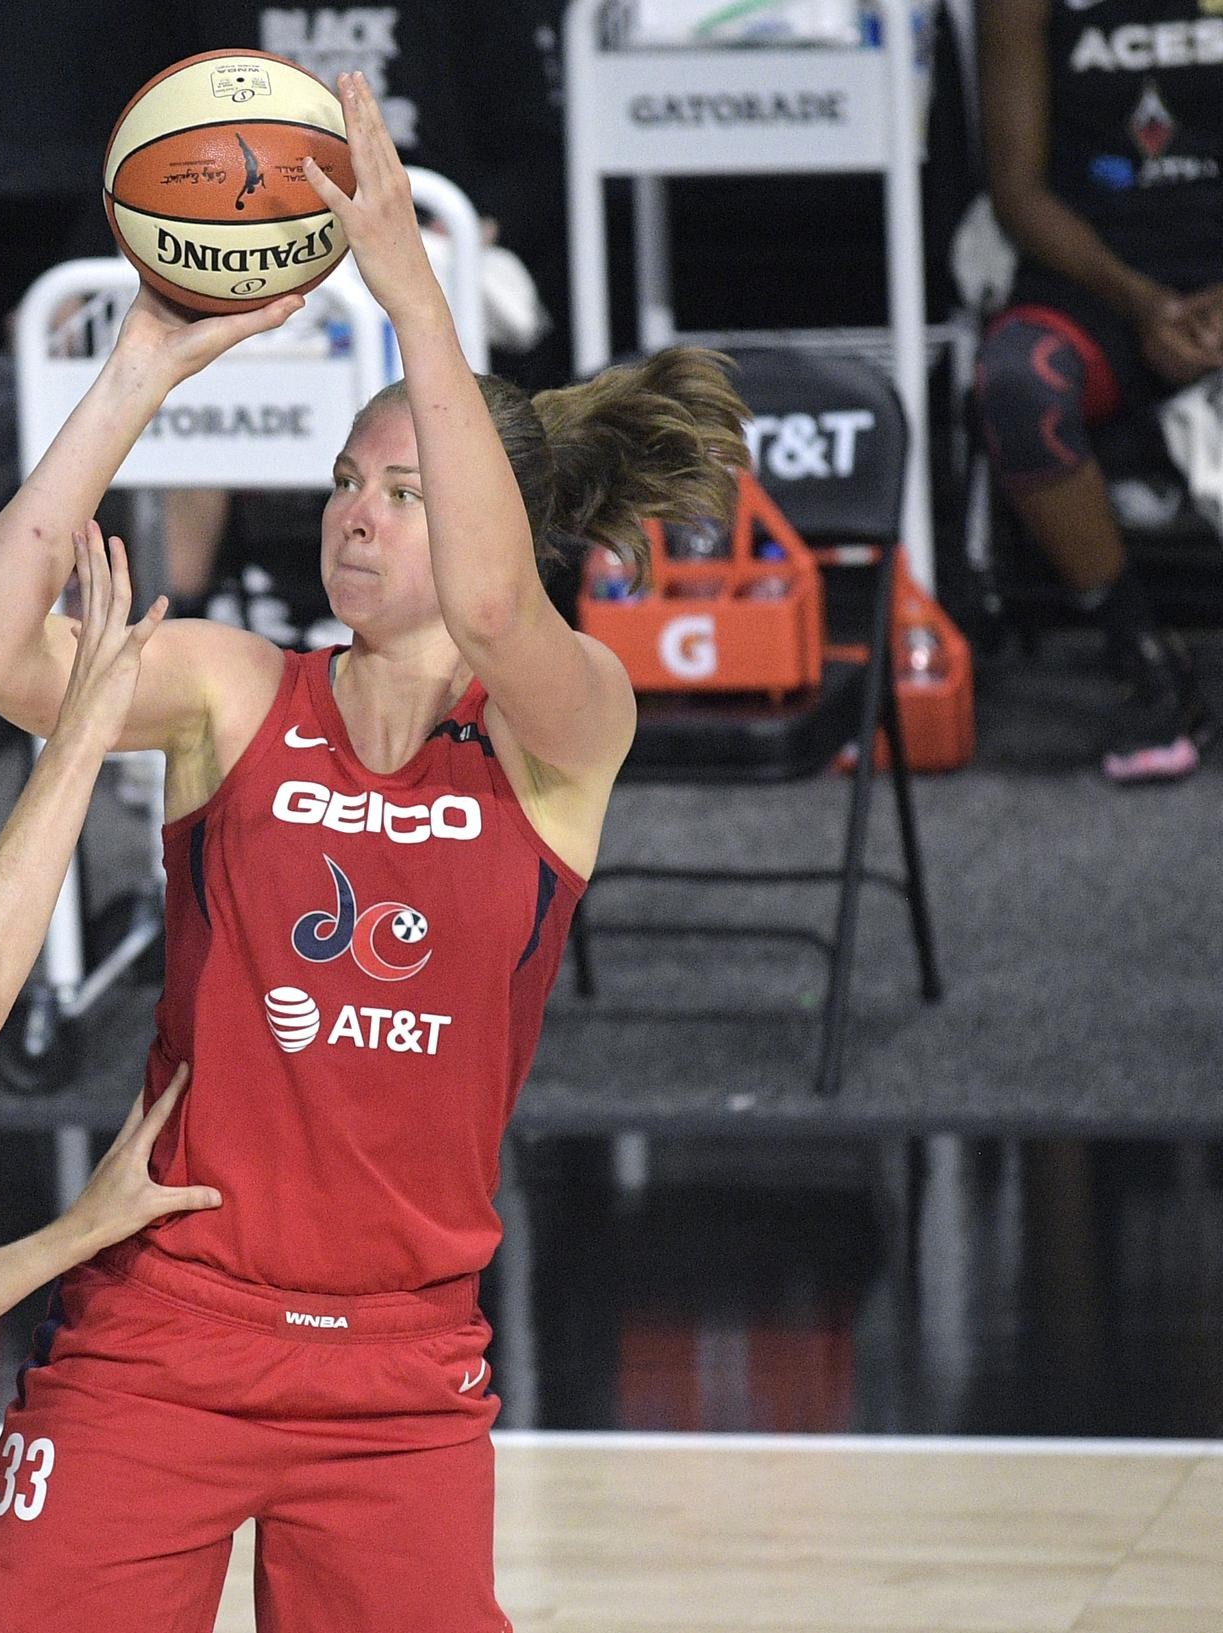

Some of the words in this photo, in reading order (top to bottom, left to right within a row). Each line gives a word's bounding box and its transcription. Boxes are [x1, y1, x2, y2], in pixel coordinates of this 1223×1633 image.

[1071, 19, 1223, 71] ACES
[631, 92, 848, 127] GATORADE
[156, 218, 335, 273] SPALDING
[148, 404, 313, 438] TORADE
[740, 410, 875, 480] T&T
[658, 614, 718, 681] G
[272, 779, 482, 844] GEICO
[327, 1004, 452, 1056] AT&T
[285, 1311, 349, 1329] WNBA
